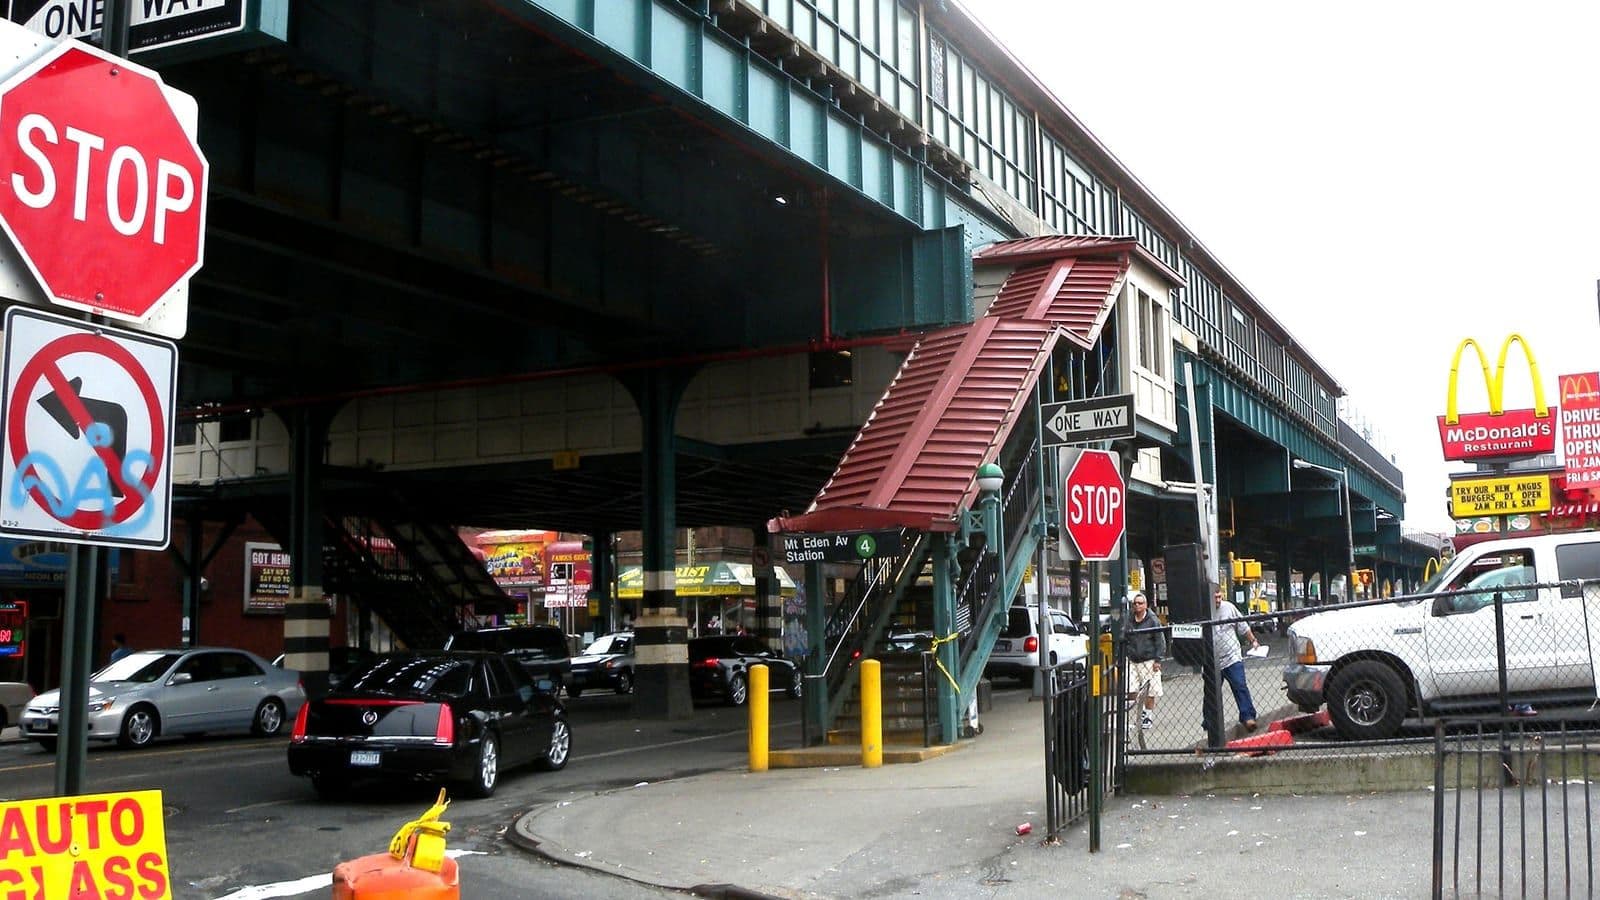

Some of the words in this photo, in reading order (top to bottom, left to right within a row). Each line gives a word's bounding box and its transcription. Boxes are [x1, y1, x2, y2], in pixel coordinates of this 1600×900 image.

[45, 0, 103, 38] ONE
[11, 113, 194, 244] STOP
[1055, 414, 1080, 432] ONE
[1093, 409, 1121, 427] WAY
[1563, 408, 1600, 423] DRIVE
[1447, 422, 1550, 442] McDonald's
[1564, 424, 1600, 439] THRU
[1464, 440, 1533, 452] Restaurant
[1566, 440, 1600, 455] OPEN
[1567, 457, 1581, 468] TIL
[1567, 472, 1580, 483] FRI
[1456, 487, 1471, 495] TRY
[1517, 482, 1541, 491] ANGUS
[1071, 484, 1120, 525] STOP
[1461, 494, 1495, 503] BURGERS
[1522, 491, 1541, 499] OPEN
[1495, 501, 1507, 509] FRI
[1521, 499, 1535, 507] SAT
[784, 539, 798, 550] Mt
[803, 537, 830, 549] Eden
[835, 535, 848, 546] Av
[860, 540, 870, 552] 4
[252, 552, 269, 564] GOT
[786, 551, 824, 562] Station
[0, 798, 144, 860] AUTO
